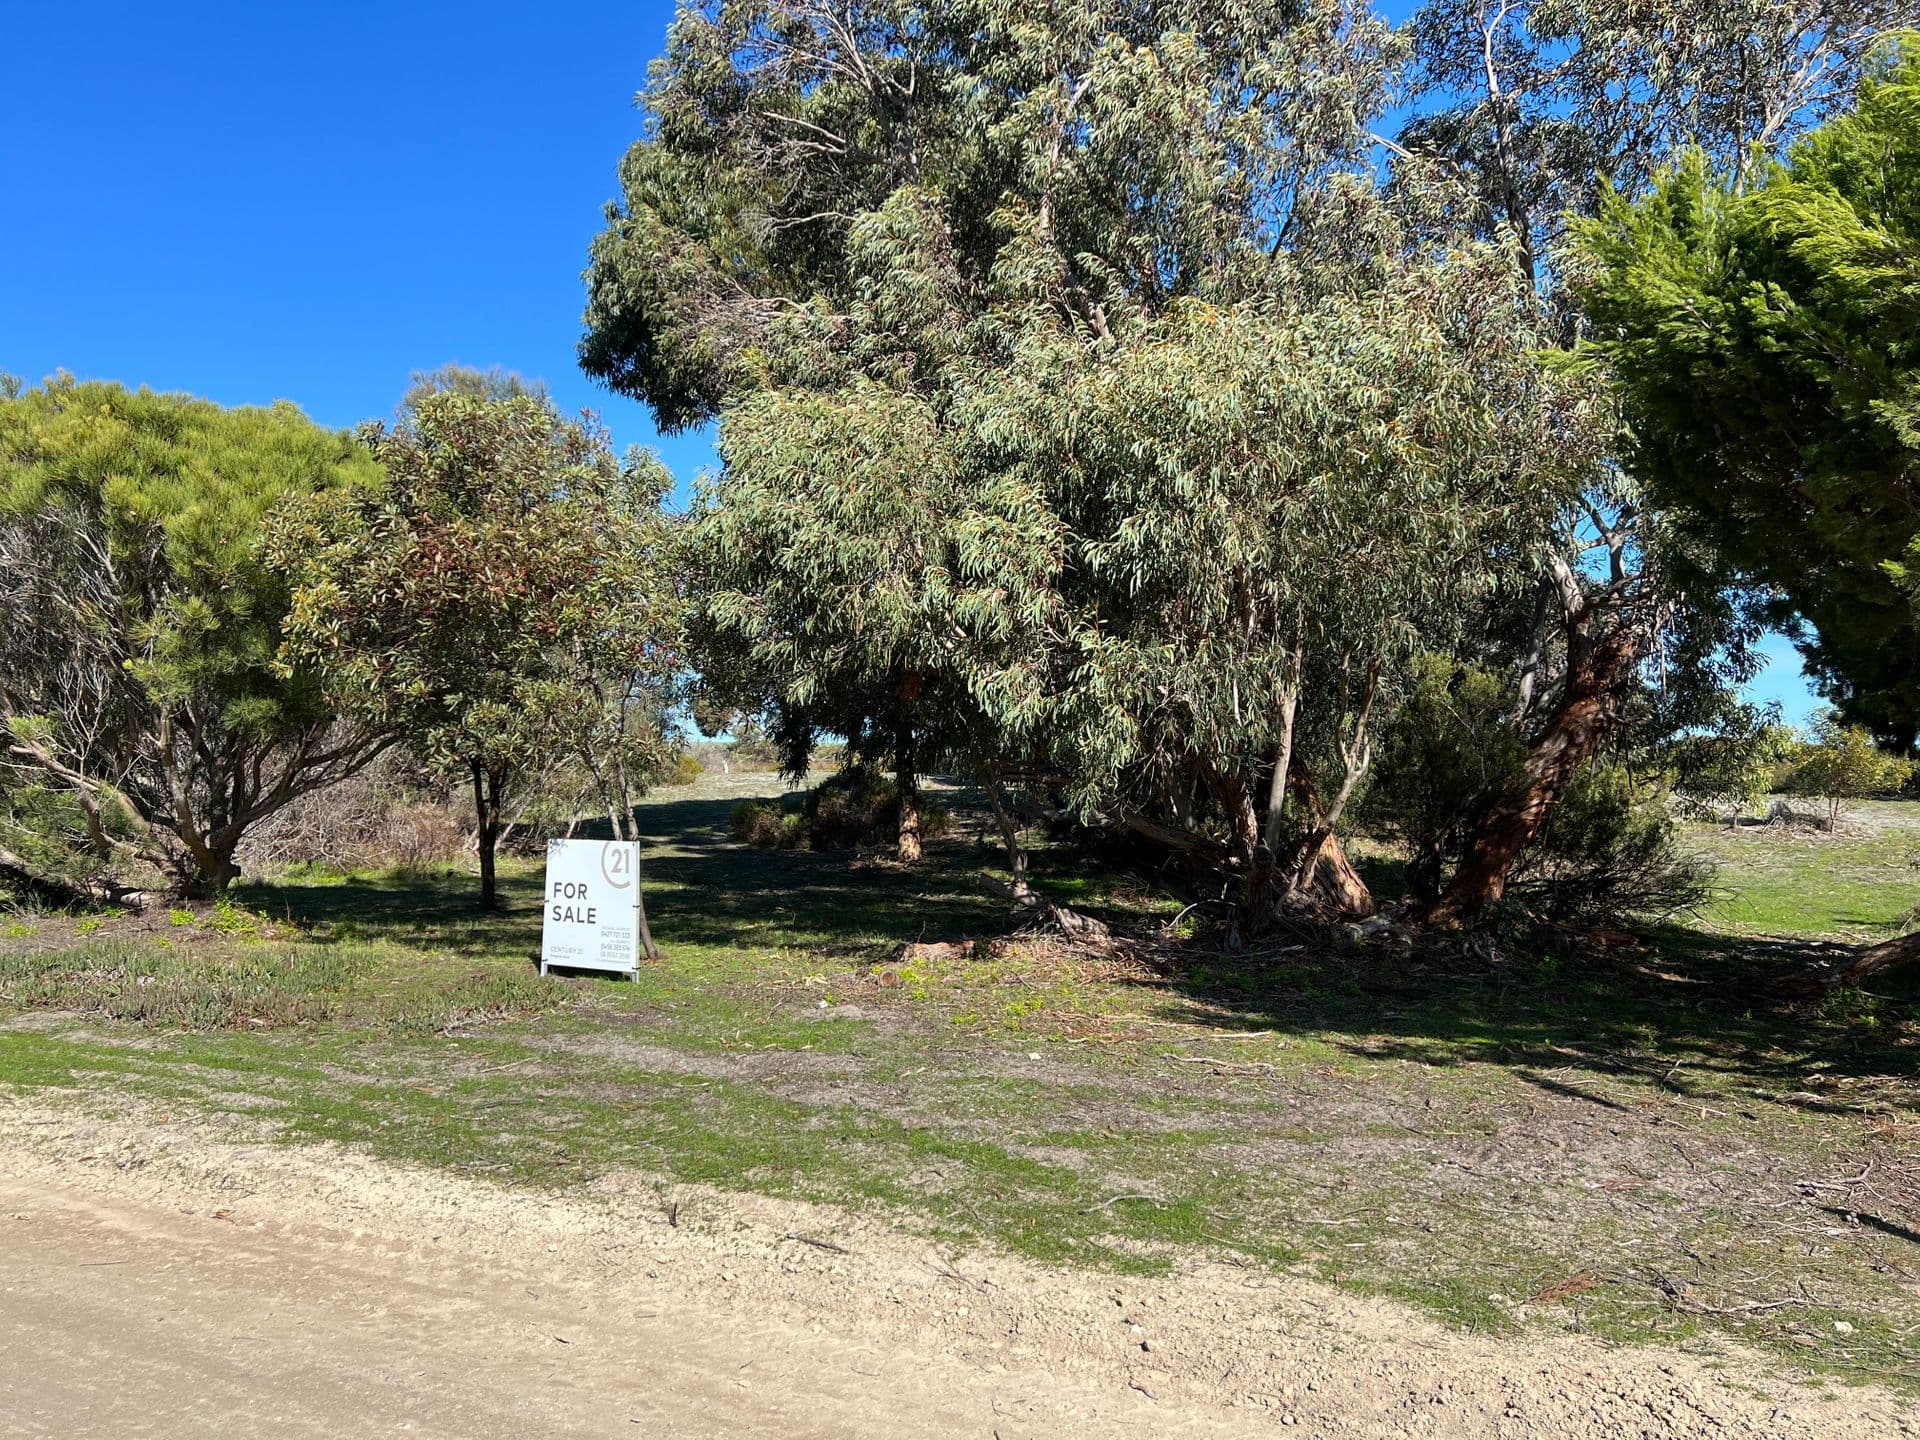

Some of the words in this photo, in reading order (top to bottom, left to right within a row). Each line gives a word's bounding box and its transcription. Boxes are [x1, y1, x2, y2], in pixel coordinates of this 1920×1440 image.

[611, 848, 630, 874] 21
[553, 882, 588, 900] FOR
[552, 905, 597, 924] SALE
[550, 945, 577, 955] CENTURY
